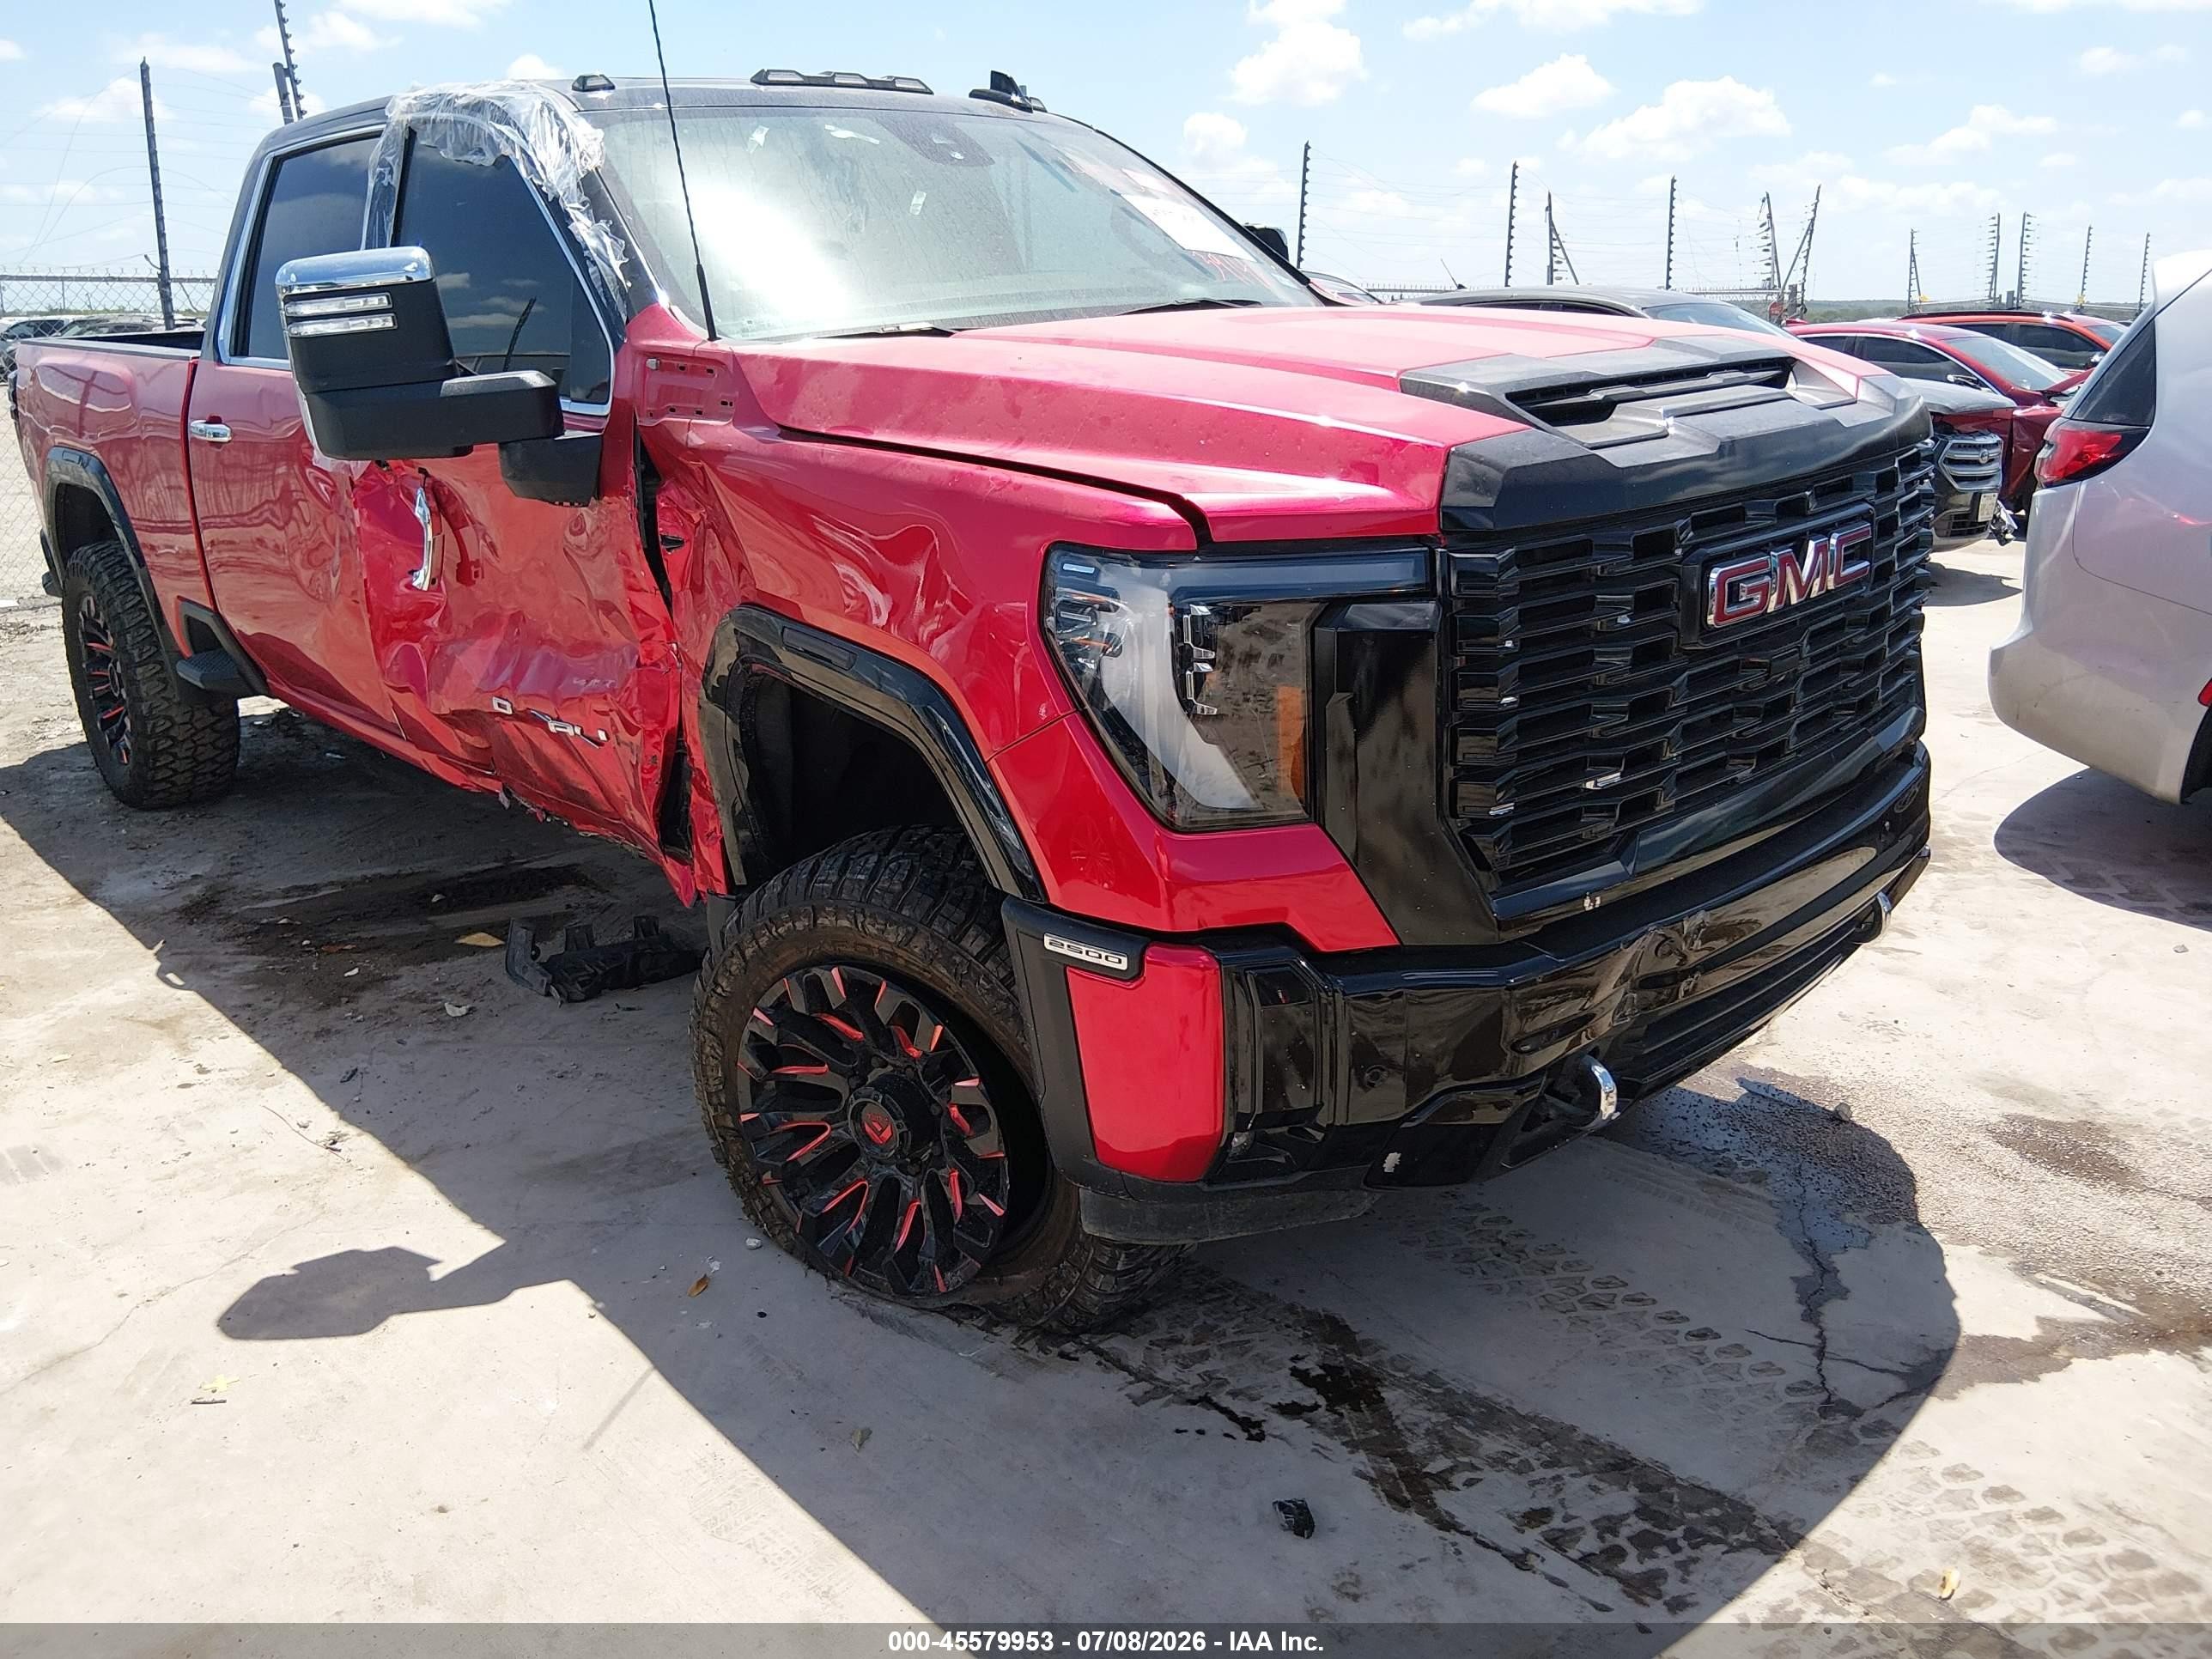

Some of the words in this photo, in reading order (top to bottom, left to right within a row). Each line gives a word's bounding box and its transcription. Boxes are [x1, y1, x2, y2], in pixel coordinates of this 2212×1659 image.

[1707, 520, 1872, 628] GMC
[492, 696, 609, 749] DALI
[1048, 939, 1122, 965] 2500
